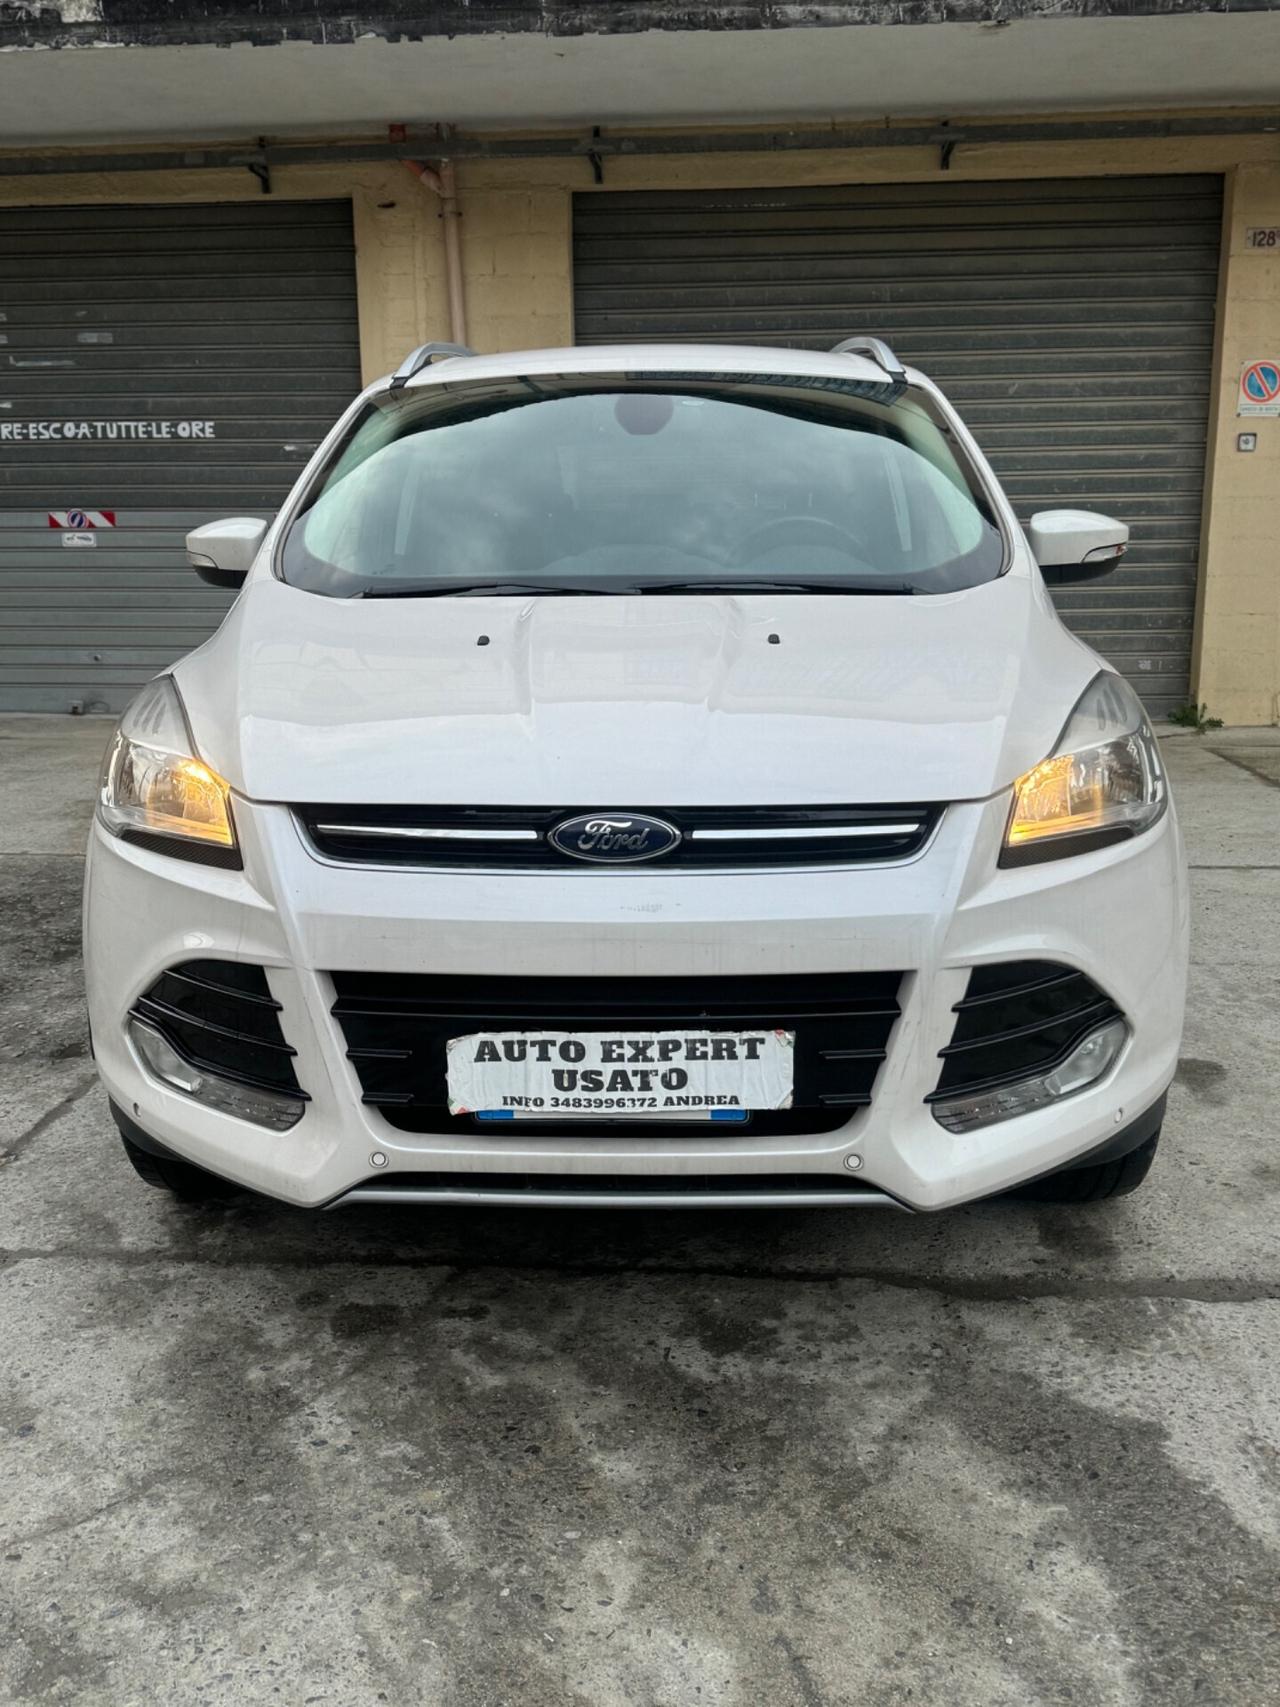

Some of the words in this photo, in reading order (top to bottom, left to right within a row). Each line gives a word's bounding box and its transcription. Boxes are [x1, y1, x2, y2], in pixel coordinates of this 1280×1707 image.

[577, 820, 651, 850] Ford
[474, 1040, 587, 1063] AUTO
[600, 1038, 765, 1063] EXPERT
[552, 1067, 688, 1092] USATO
[502, 1095, 545, 1107] INFO
[663, 1095, 740, 1107] ANDREA
